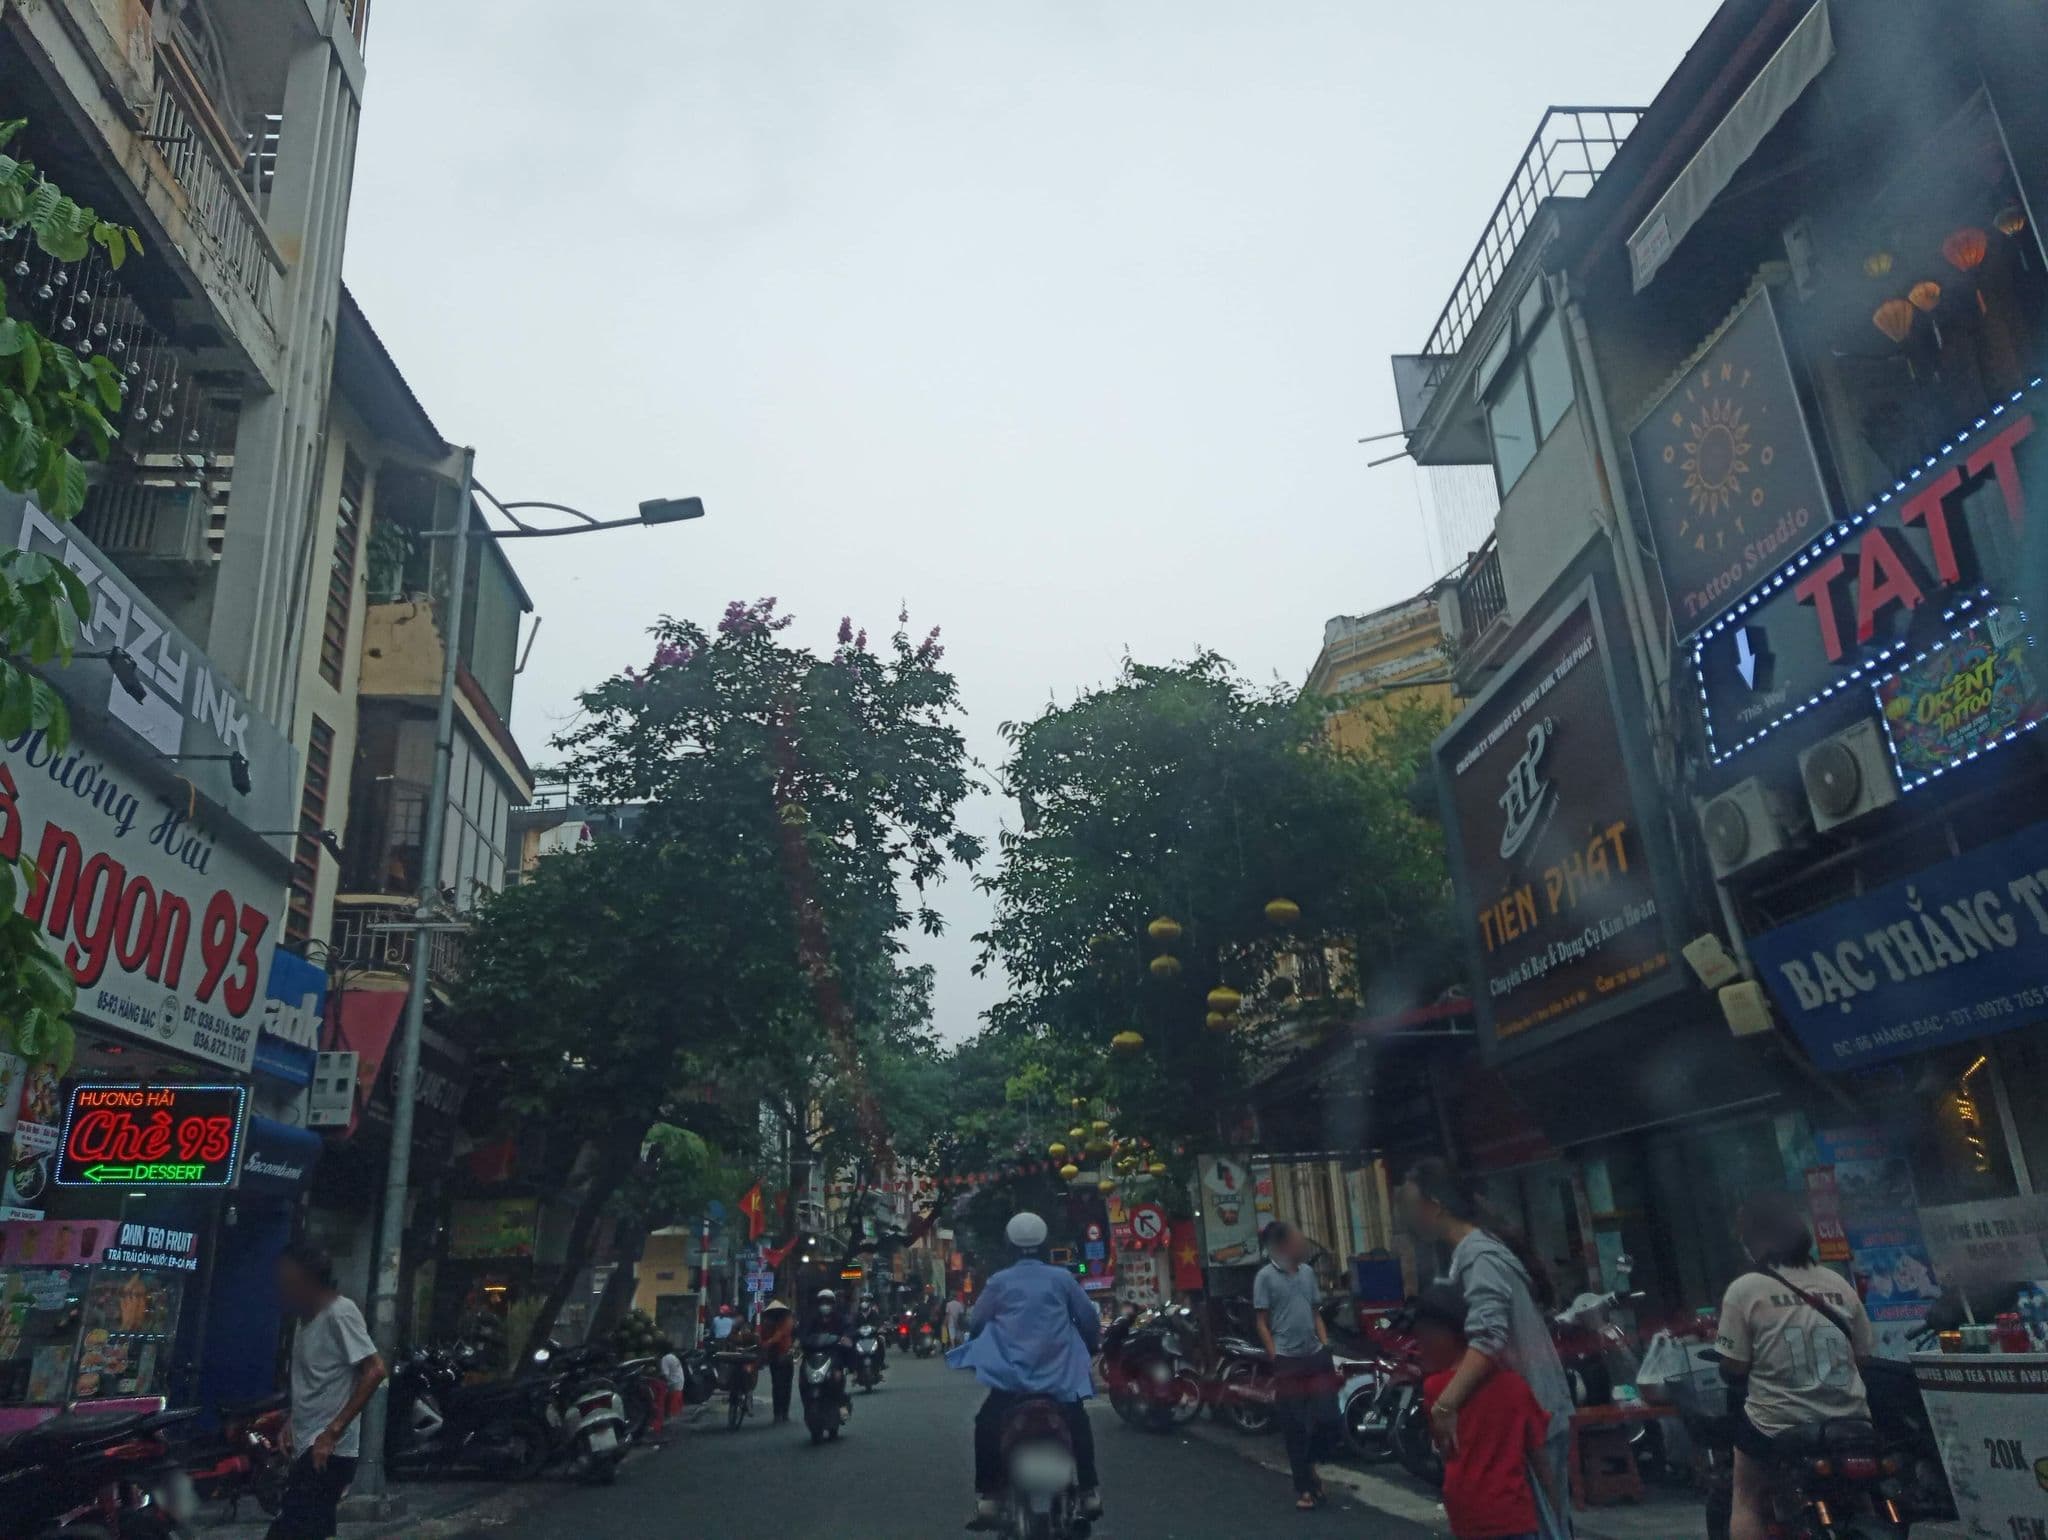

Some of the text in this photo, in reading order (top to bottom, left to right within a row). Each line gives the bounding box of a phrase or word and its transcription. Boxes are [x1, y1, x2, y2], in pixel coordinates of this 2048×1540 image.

[1682, 506, 1810, 618] Tattoo Studio
[192, 666, 250, 762] INK
[23, 820, 269, 1018] ngon 93
[1780, 867, 2048, 1014] BẠC THẮNG T
[79, 1089, 175, 1106] HƯƠNG HẢI
[68, 1110, 173, 1162] Chè
[177, 1115, 232, 1162] 93
[134, 1164, 206, 1181] DESSERT
[146, 1227, 165, 1249] TEA
[165, 1230, 194, 1253] FRUIT
[1965, 1368, 1986, 1383] TEA
[1986, 1368, 2017, 1383] TAKE
[1983, 1437, 2031, 1471] 20K
